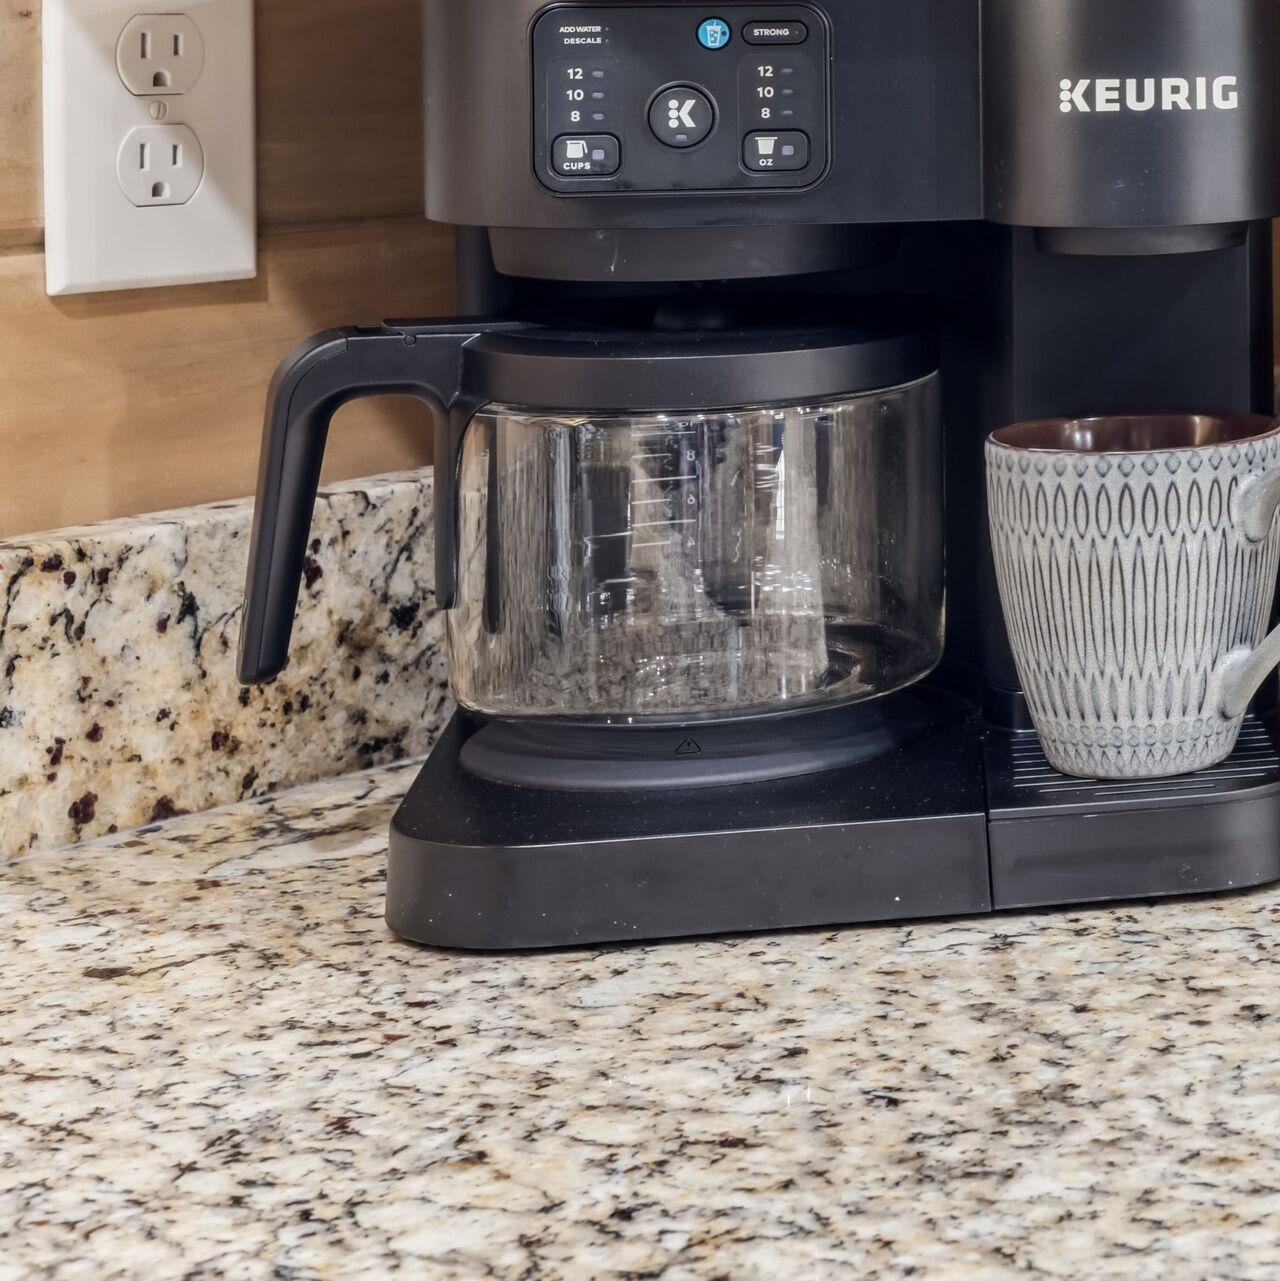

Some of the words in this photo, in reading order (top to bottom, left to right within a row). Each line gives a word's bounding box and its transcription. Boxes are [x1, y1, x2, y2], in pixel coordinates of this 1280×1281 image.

[753, 28, 790, 36] STRONG
[564, 37, 602, 45] DESCALE
[567, 68, 583, 79] 12
[757, 65, 774, 77] 12
[566, 89, 584, 101] 10
[757, 86, 774, 98] 10
[1059, 75, 1238, 113] KEURIG
[570, 110, 580, 122] 8
[761, 108, 771, 119] 8
[563, 162, 591, 170] CUPS
